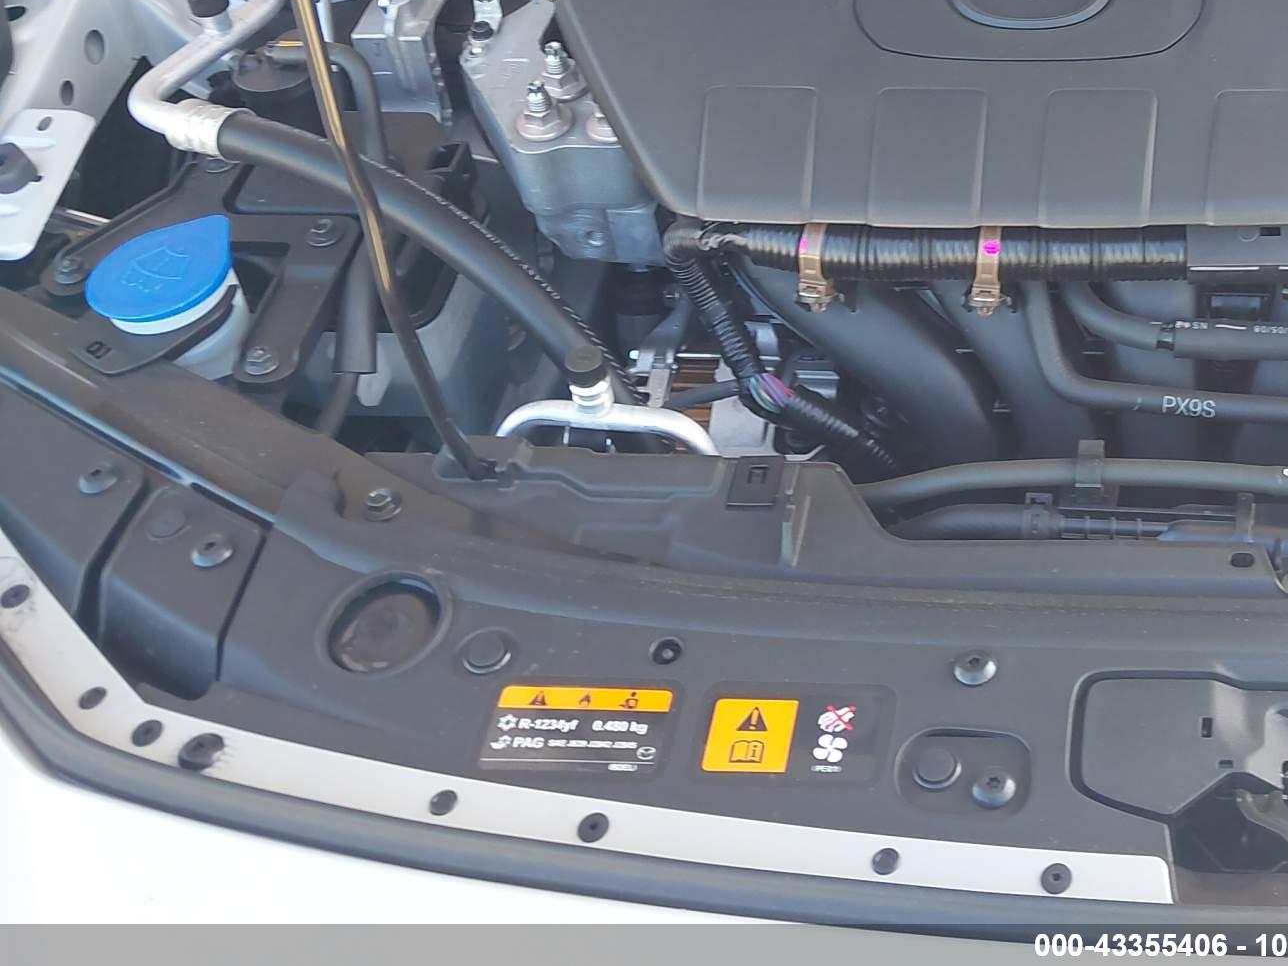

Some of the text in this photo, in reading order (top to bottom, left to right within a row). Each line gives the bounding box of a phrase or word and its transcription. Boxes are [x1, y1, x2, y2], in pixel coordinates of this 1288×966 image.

[1161, 395, 1217, 418] PX9S
[517, 718, 580, 733] R-1234yf
[629, 721, 649, 735] kg
[511, 737, 545, 749] PAG
